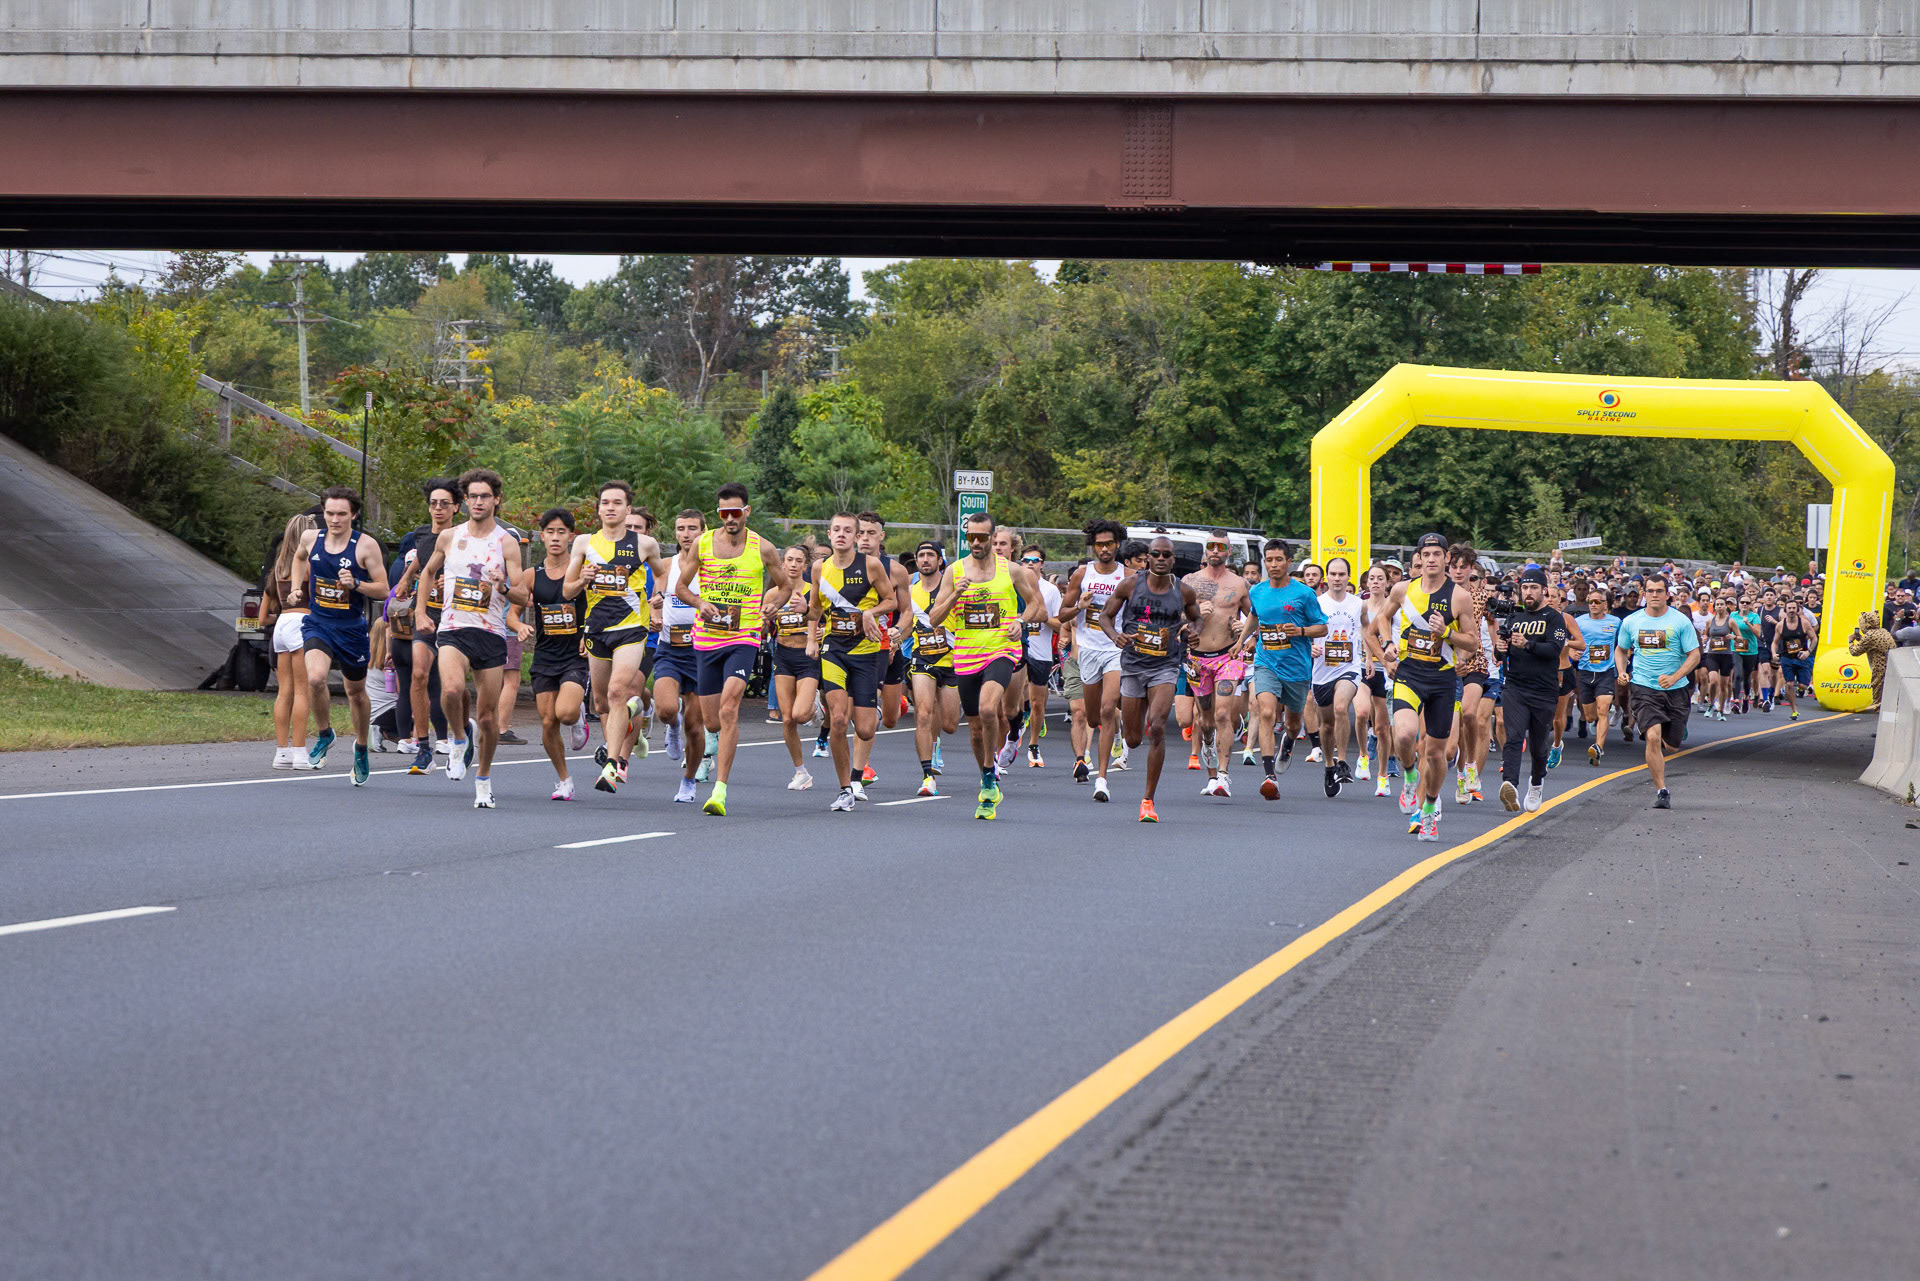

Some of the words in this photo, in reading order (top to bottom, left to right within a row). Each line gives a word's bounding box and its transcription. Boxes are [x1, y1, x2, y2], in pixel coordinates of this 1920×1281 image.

[958, 476, 989, 486] BY-PASS
[962, 496, 985, 509] SOUTH
[595, 574, 626, 584] 205
[1088, 583, 1115, 591] LEONI
[320, 587, 344, 598] 137
[461, 588, 483, 600] 39
[1431, 602, 1447, 611] GSTC
[544, 614, 573, 623] 258
[712, 615, 732, 624] 94
[969, 613, 994, 623] 217
[837, 621, 856, 630] 26
[920, 635, 944, 645] 245
[1144, 634, 1162, 644] 75
[1262, 632, 1286, 640] 233
[1415, 639, 1434, 649] 97
